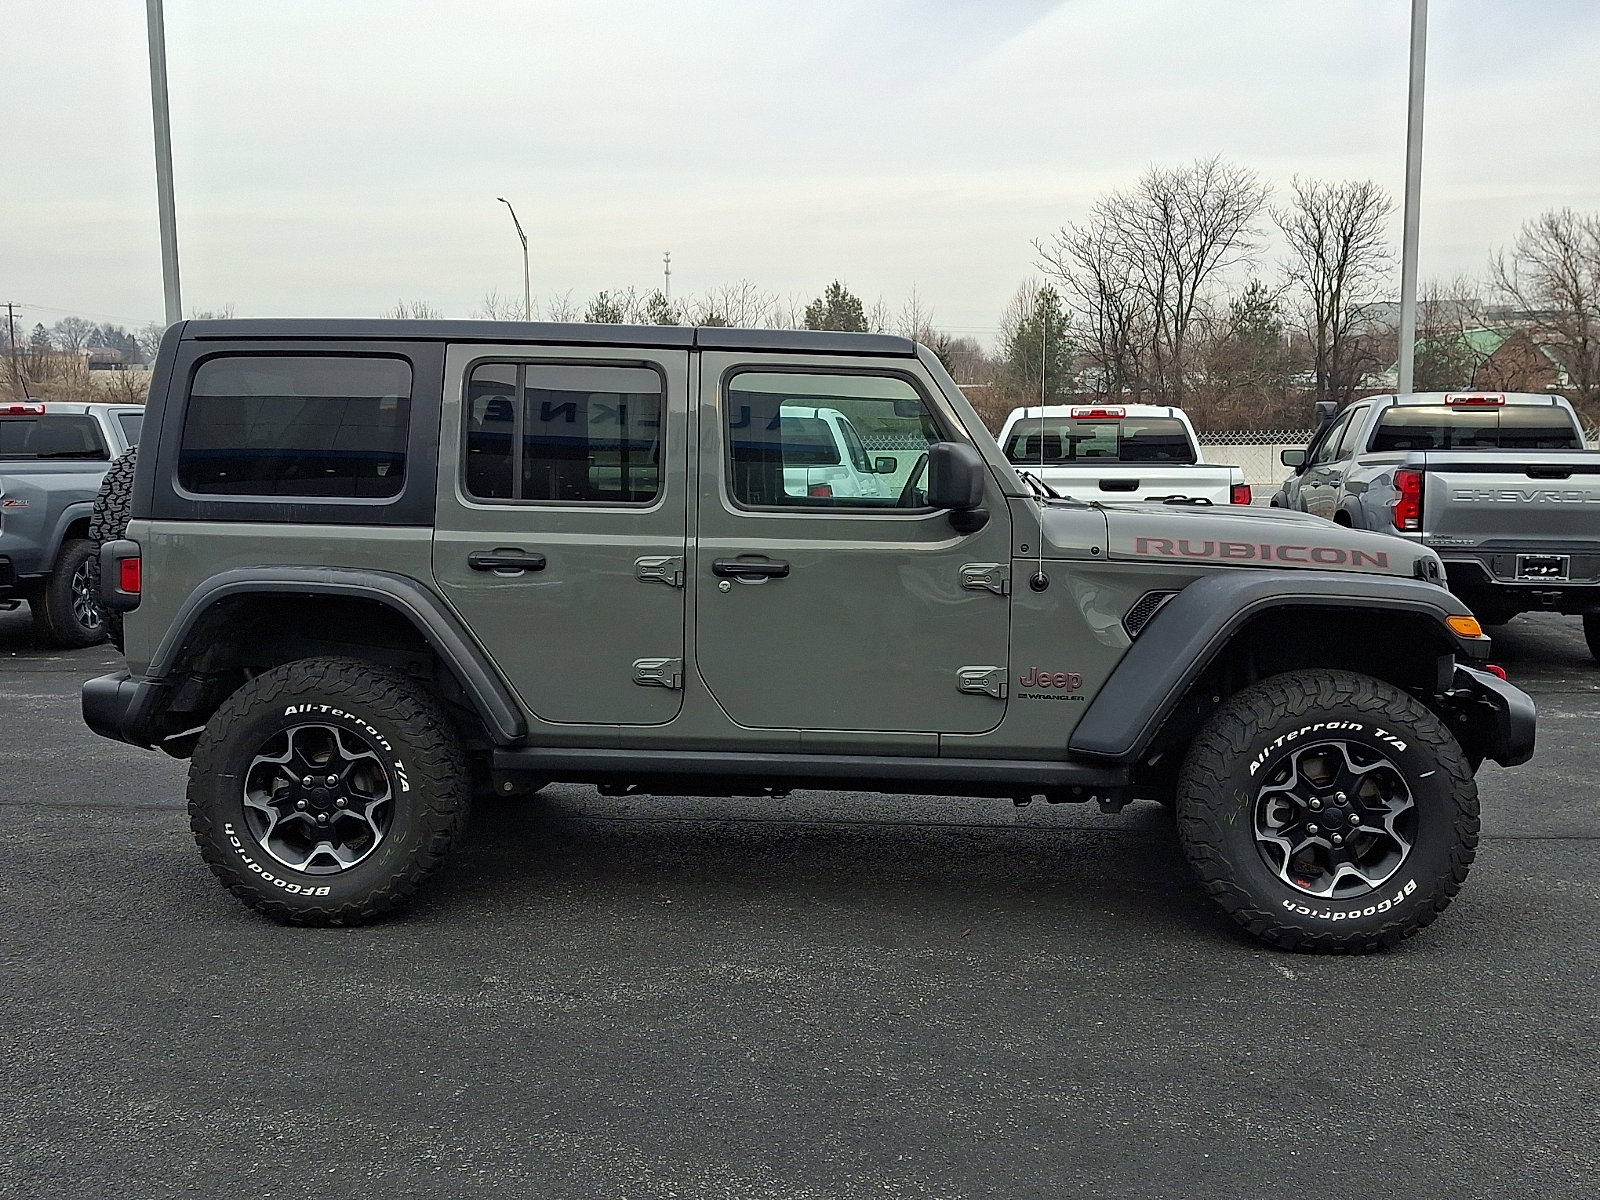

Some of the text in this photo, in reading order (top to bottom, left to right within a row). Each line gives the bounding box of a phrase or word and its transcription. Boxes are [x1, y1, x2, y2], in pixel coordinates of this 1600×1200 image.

[1134, 537, 1390, 569] RUBICON
[1020, 666, 1083, 692] Jeep
[1028, 693, 1085, 702] WRANGLER
[284, 704, 410, 793] All-Terrain T/A
[1250, 720, 1408, 776] All-Terrain T/A
[224, 822, 331, 896] BFGoodrich
[1282, 878, 1418, 922] BFGoodrich
